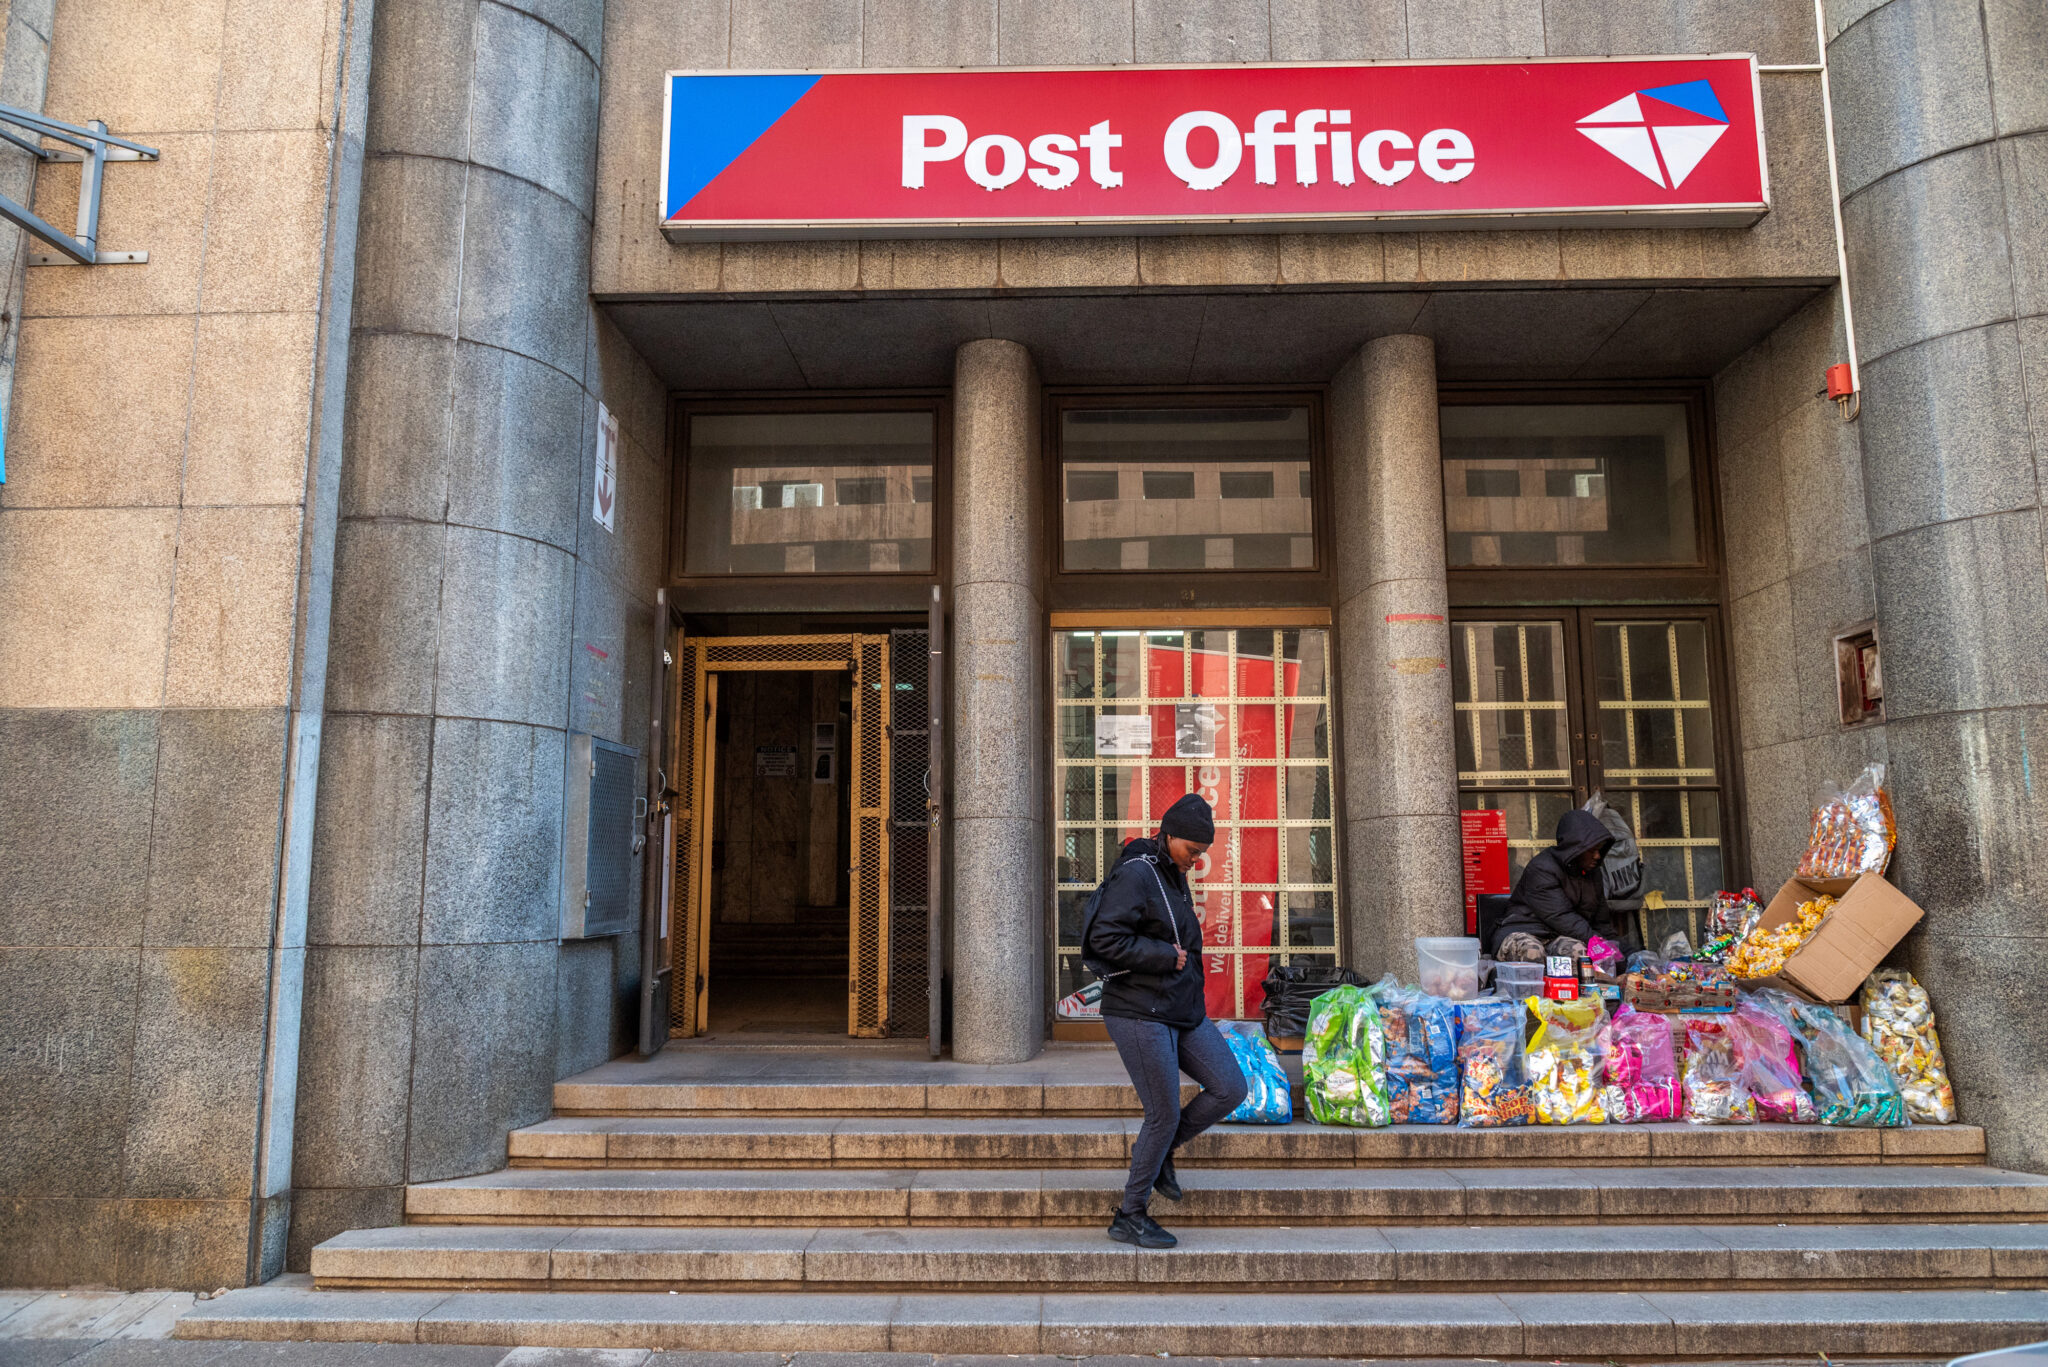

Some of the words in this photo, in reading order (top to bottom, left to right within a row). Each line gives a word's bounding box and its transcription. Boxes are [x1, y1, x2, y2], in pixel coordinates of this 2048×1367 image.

[901, 114, 1123, 191] Post
[1163, 108, 1475, 190] Office
[1611, 861, 1640, 891] NIK
[1214, 886, 1232, 944] deliver
[1500, 1096, 1528, 1112] POP
